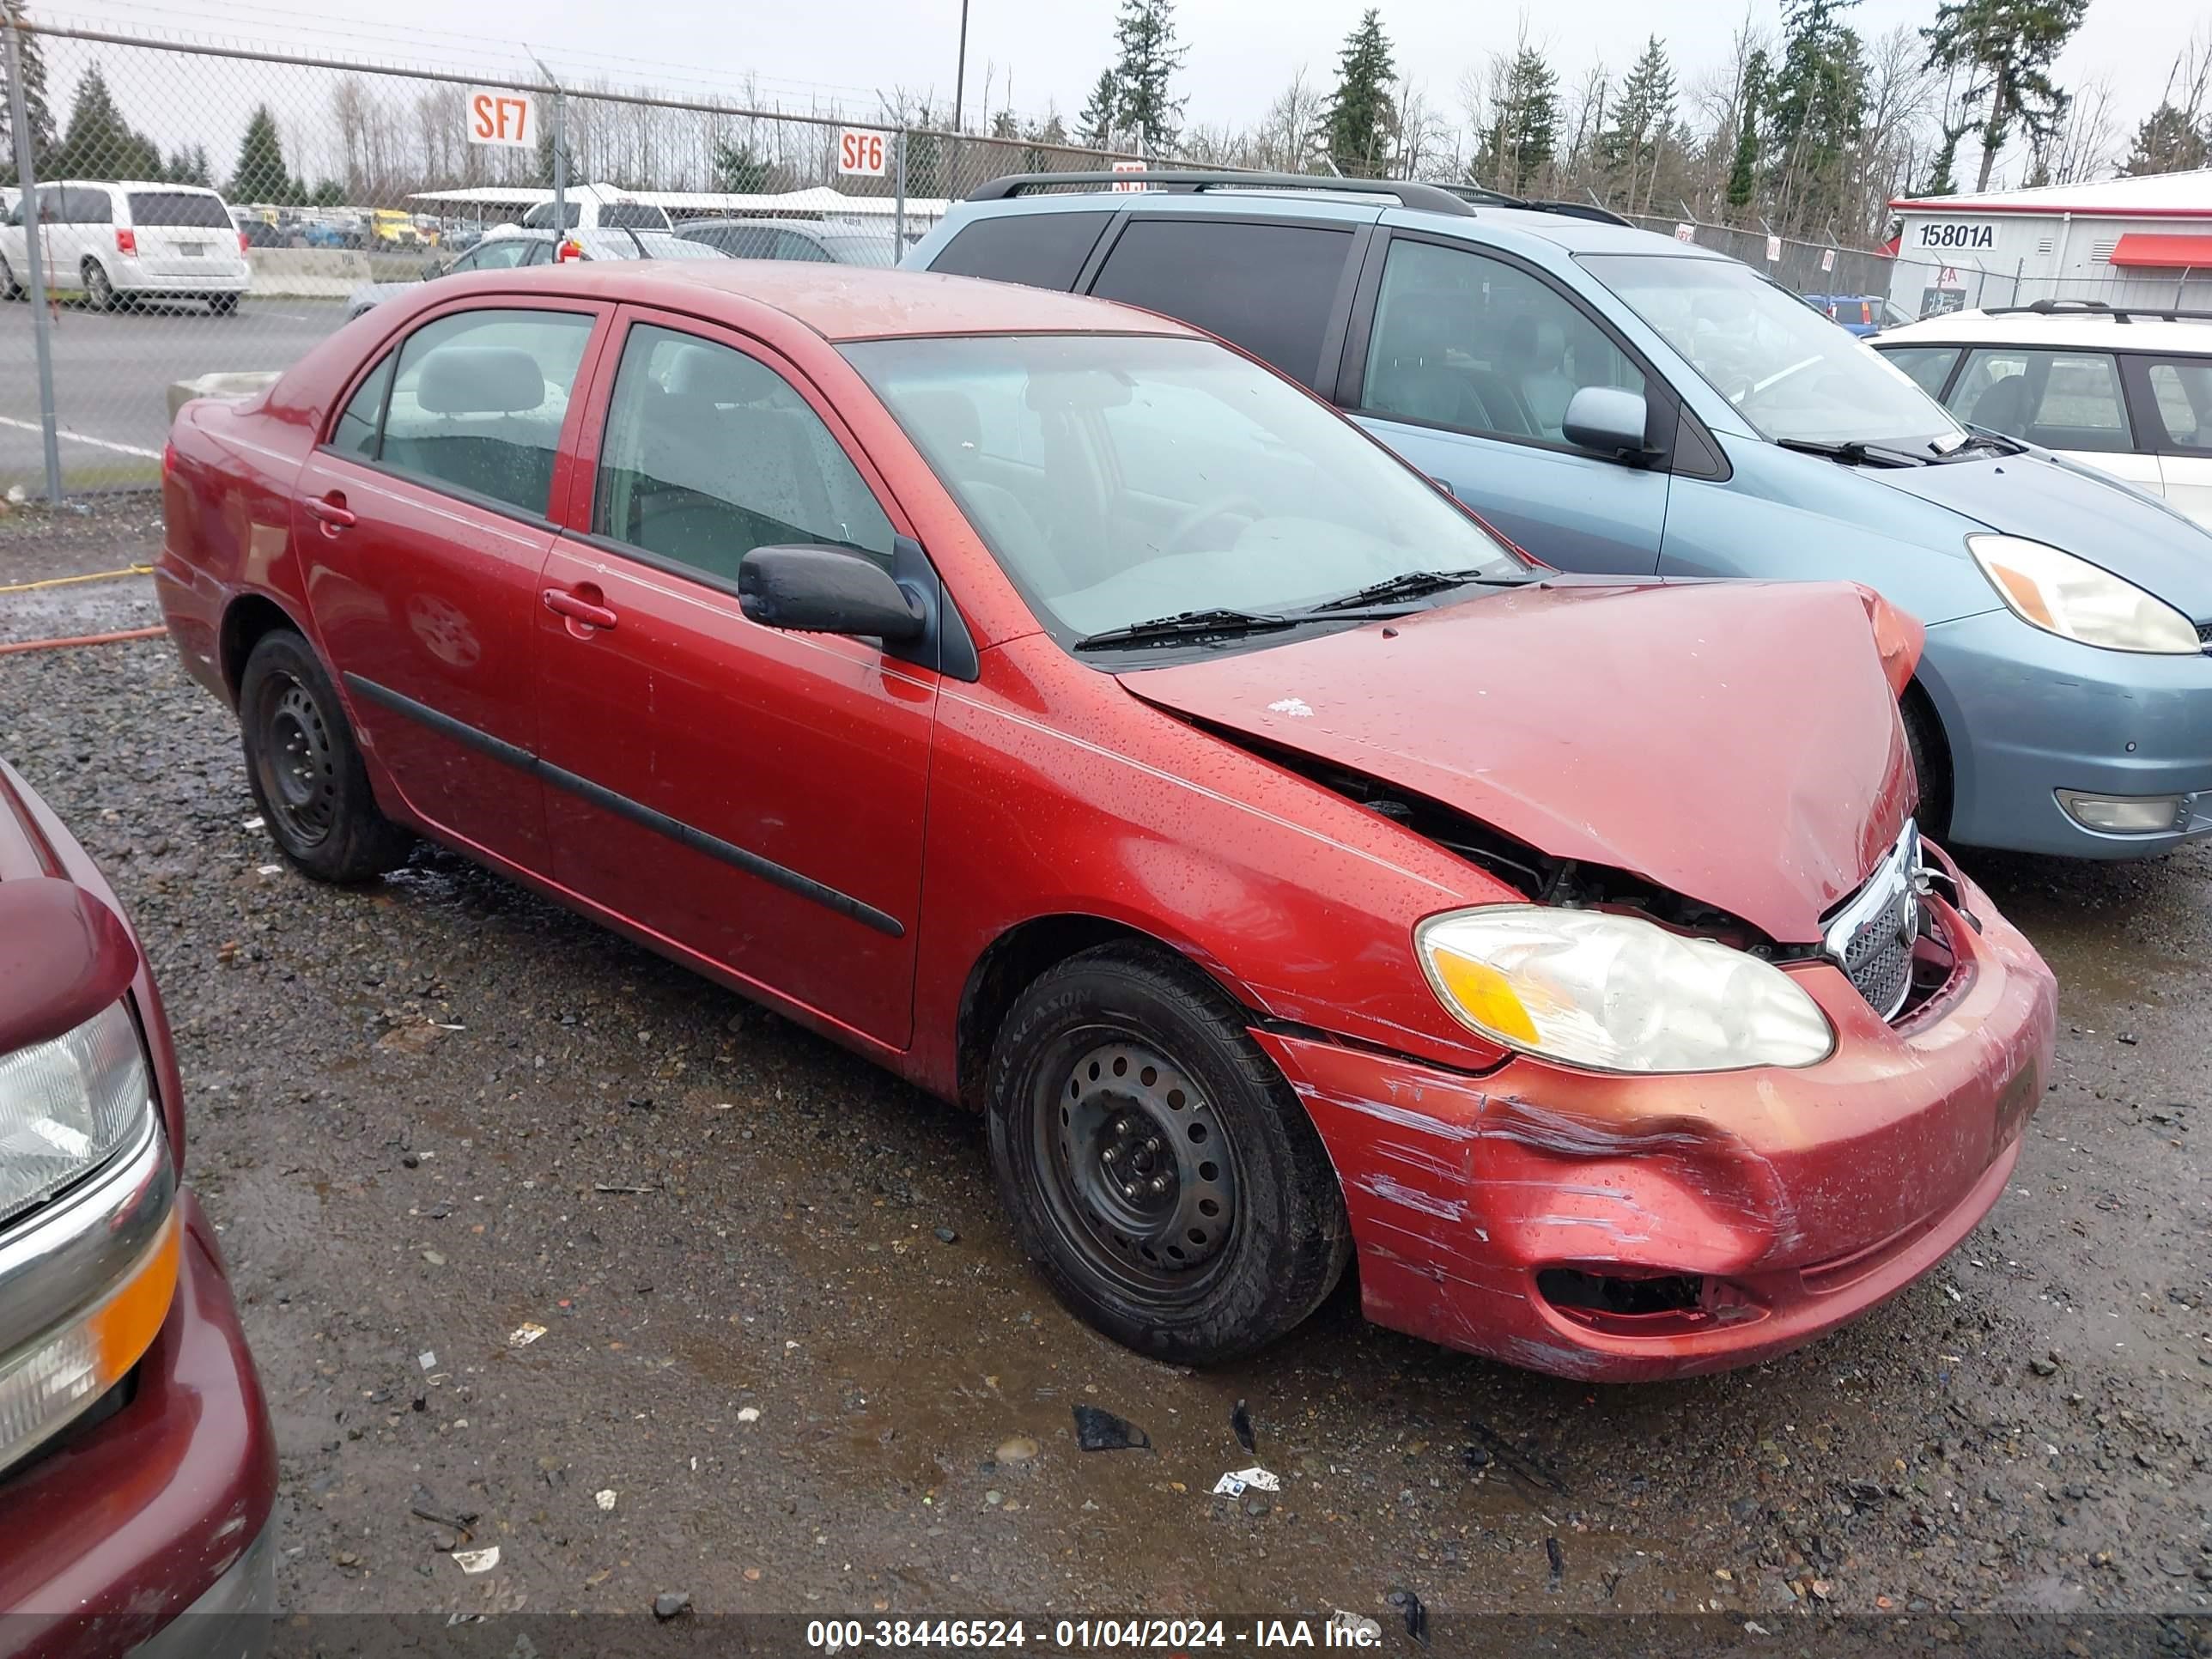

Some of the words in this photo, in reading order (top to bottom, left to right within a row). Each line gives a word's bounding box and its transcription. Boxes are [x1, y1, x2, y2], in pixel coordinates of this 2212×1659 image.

[473, 94, 526, 142] SF7
[842, 133, 882, 171] SF6
[1920, 224, 1993, 248] 15801A
